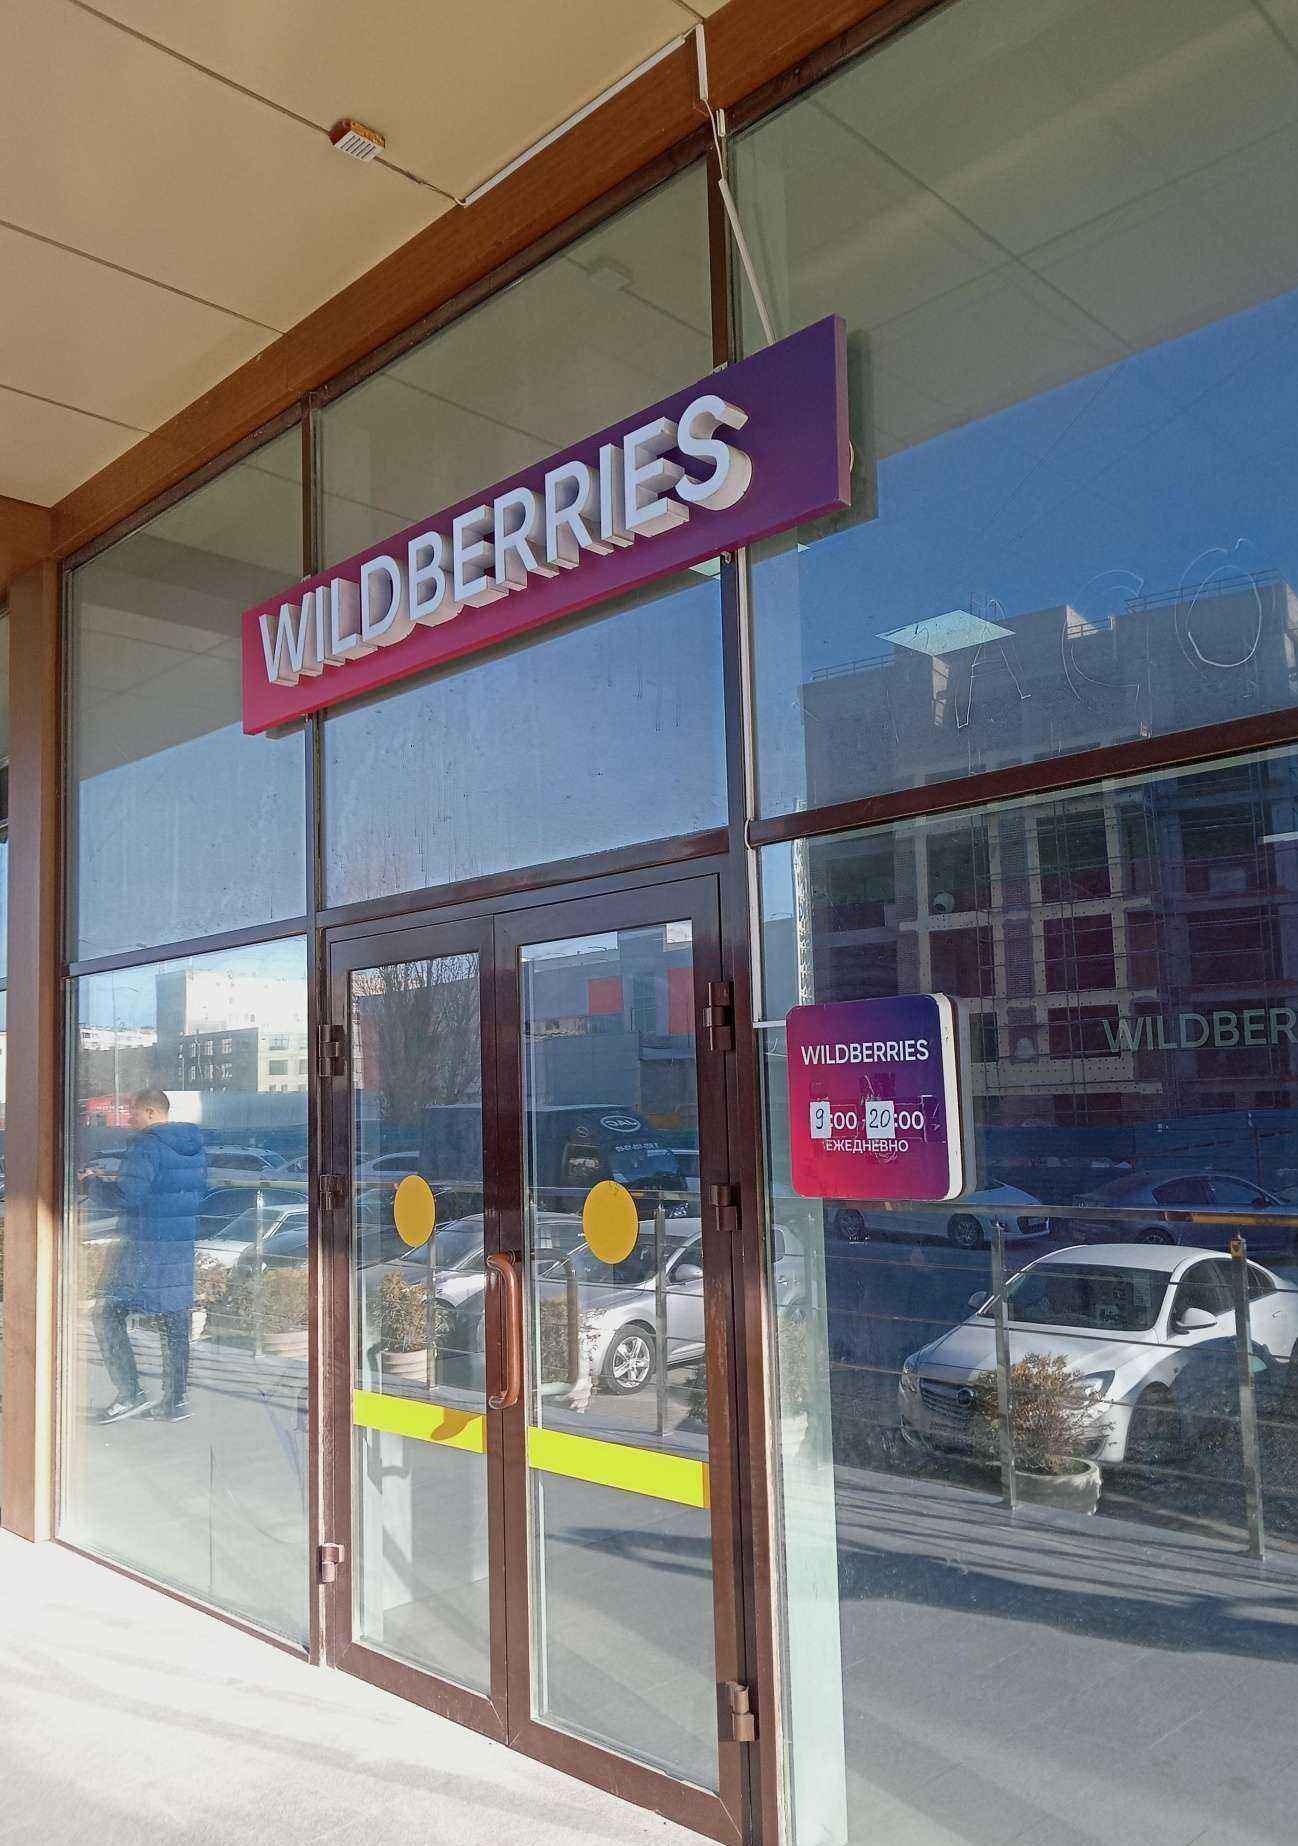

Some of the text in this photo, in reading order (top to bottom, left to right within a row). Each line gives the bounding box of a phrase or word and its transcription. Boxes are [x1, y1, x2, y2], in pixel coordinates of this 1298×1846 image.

[258, 393, 752, 687] WILDBERRIES
[1102, 1007, 1298, 1053] WILDBER
[801, 1039, 929, 1066] WILDBERRIES
[825, 1139, 909, 1154] ЕЖЕДНЕВНО
